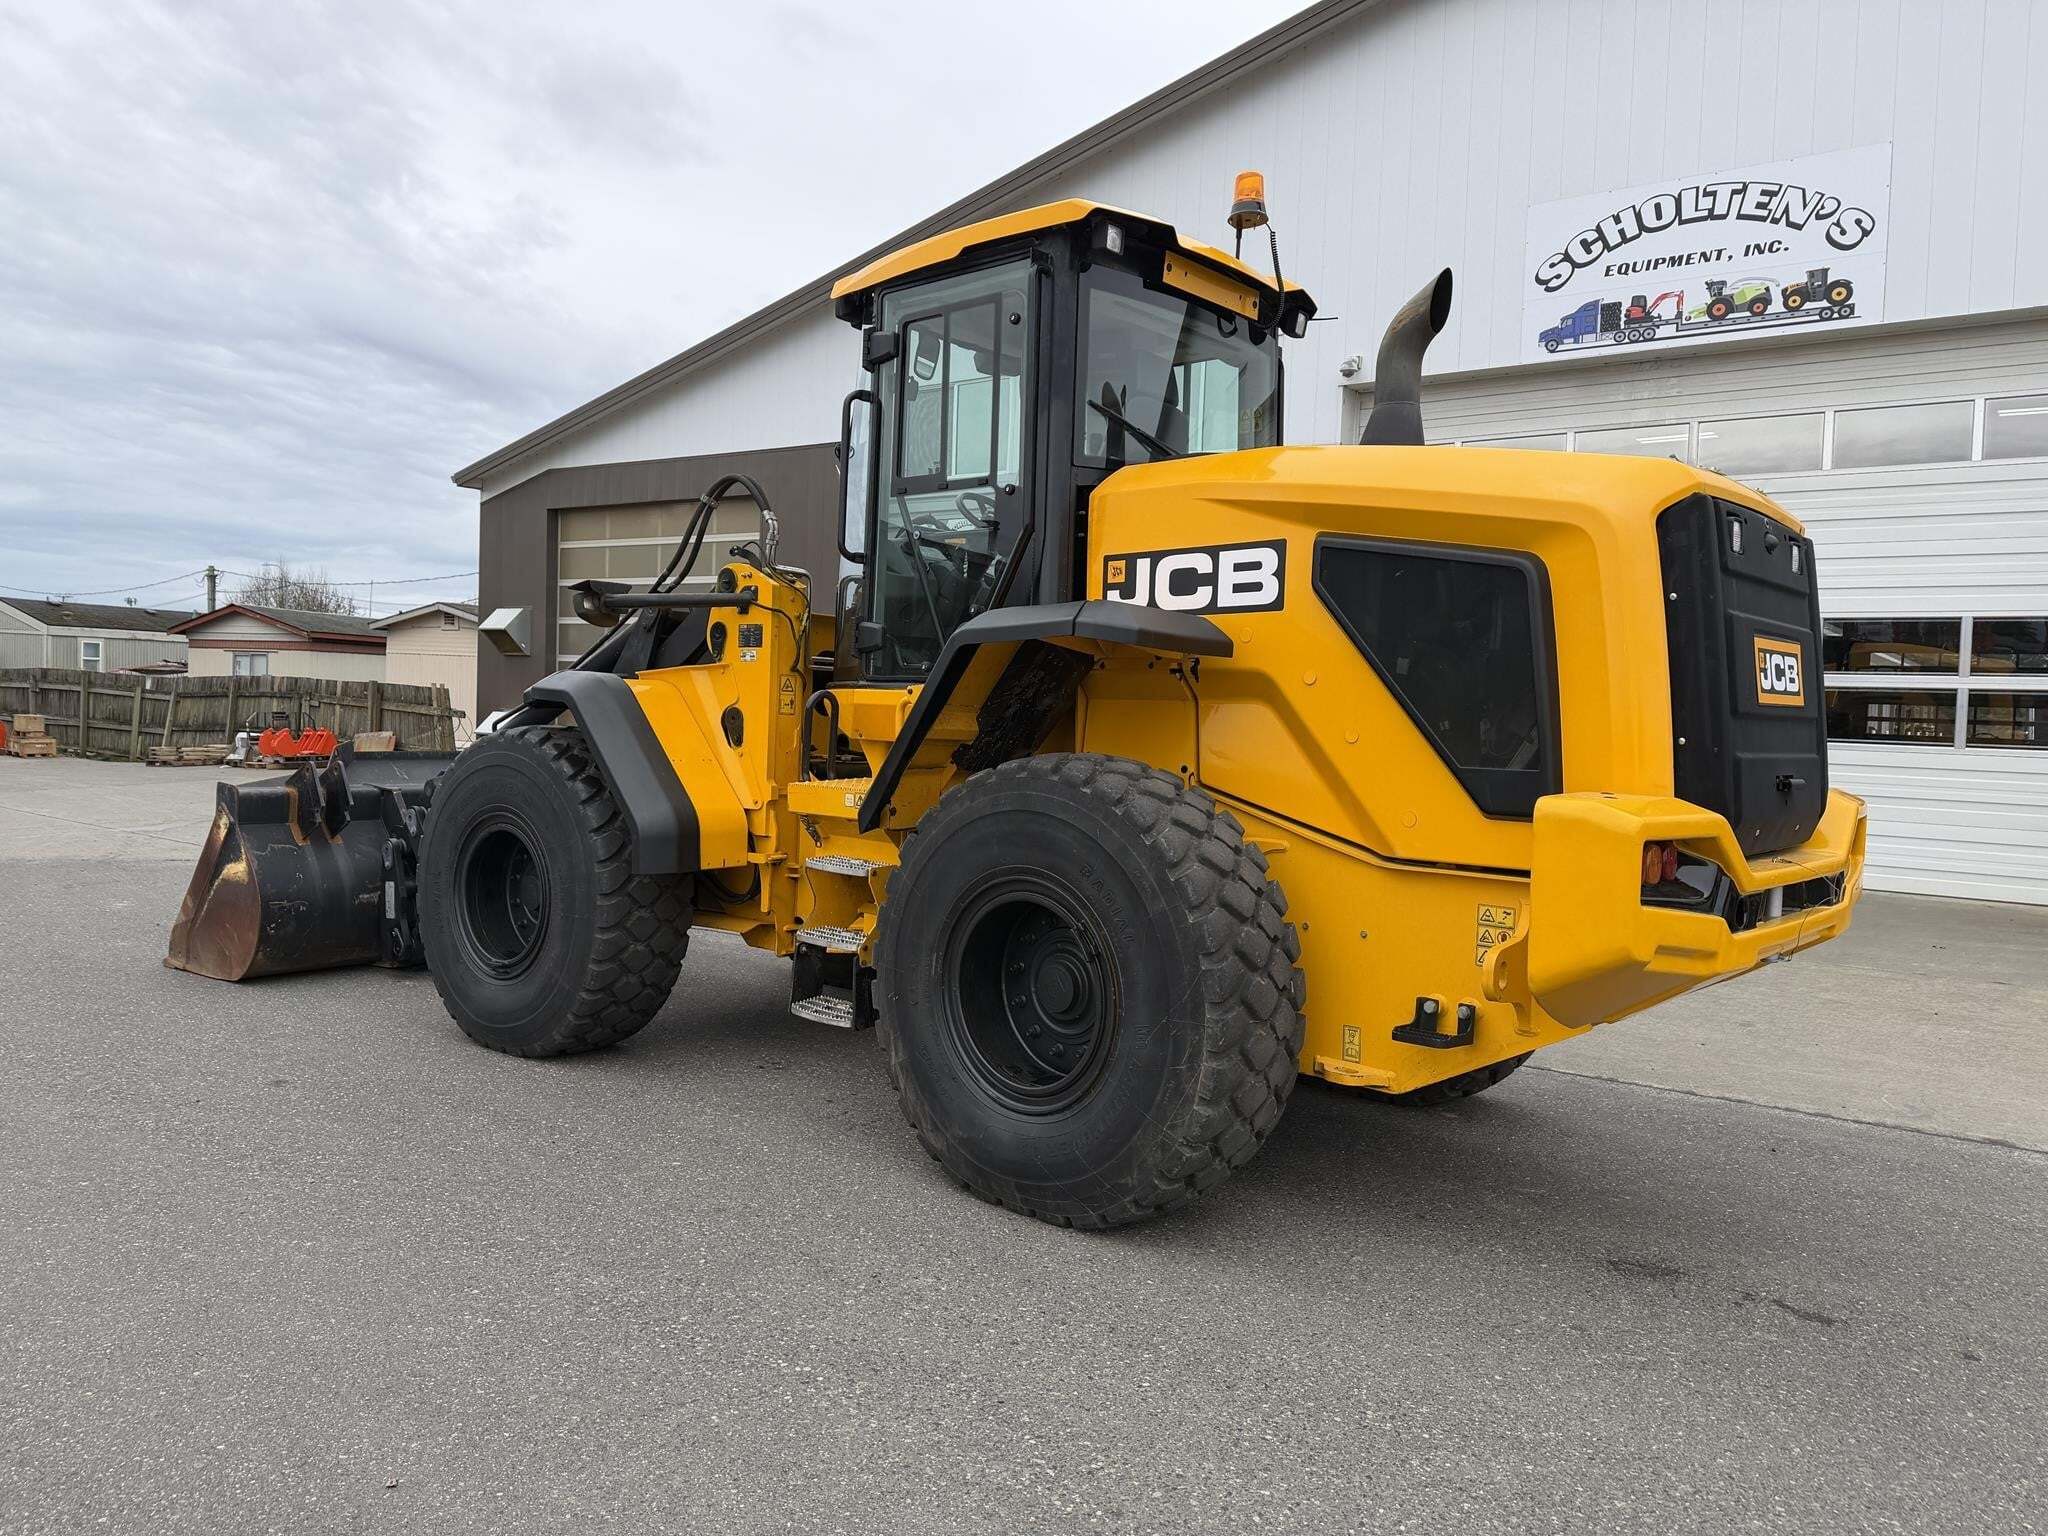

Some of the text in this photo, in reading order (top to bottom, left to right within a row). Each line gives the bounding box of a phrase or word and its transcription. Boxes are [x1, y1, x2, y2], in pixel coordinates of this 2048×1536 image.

[1535, 181, 1875, 292] SCHOLTEN'S
[1604, 239, 1790, 278] EQUIPMENT, INC.
[1106, 547, 1280, 611] JCB
[1760, 653, 1800, 692] JCB
